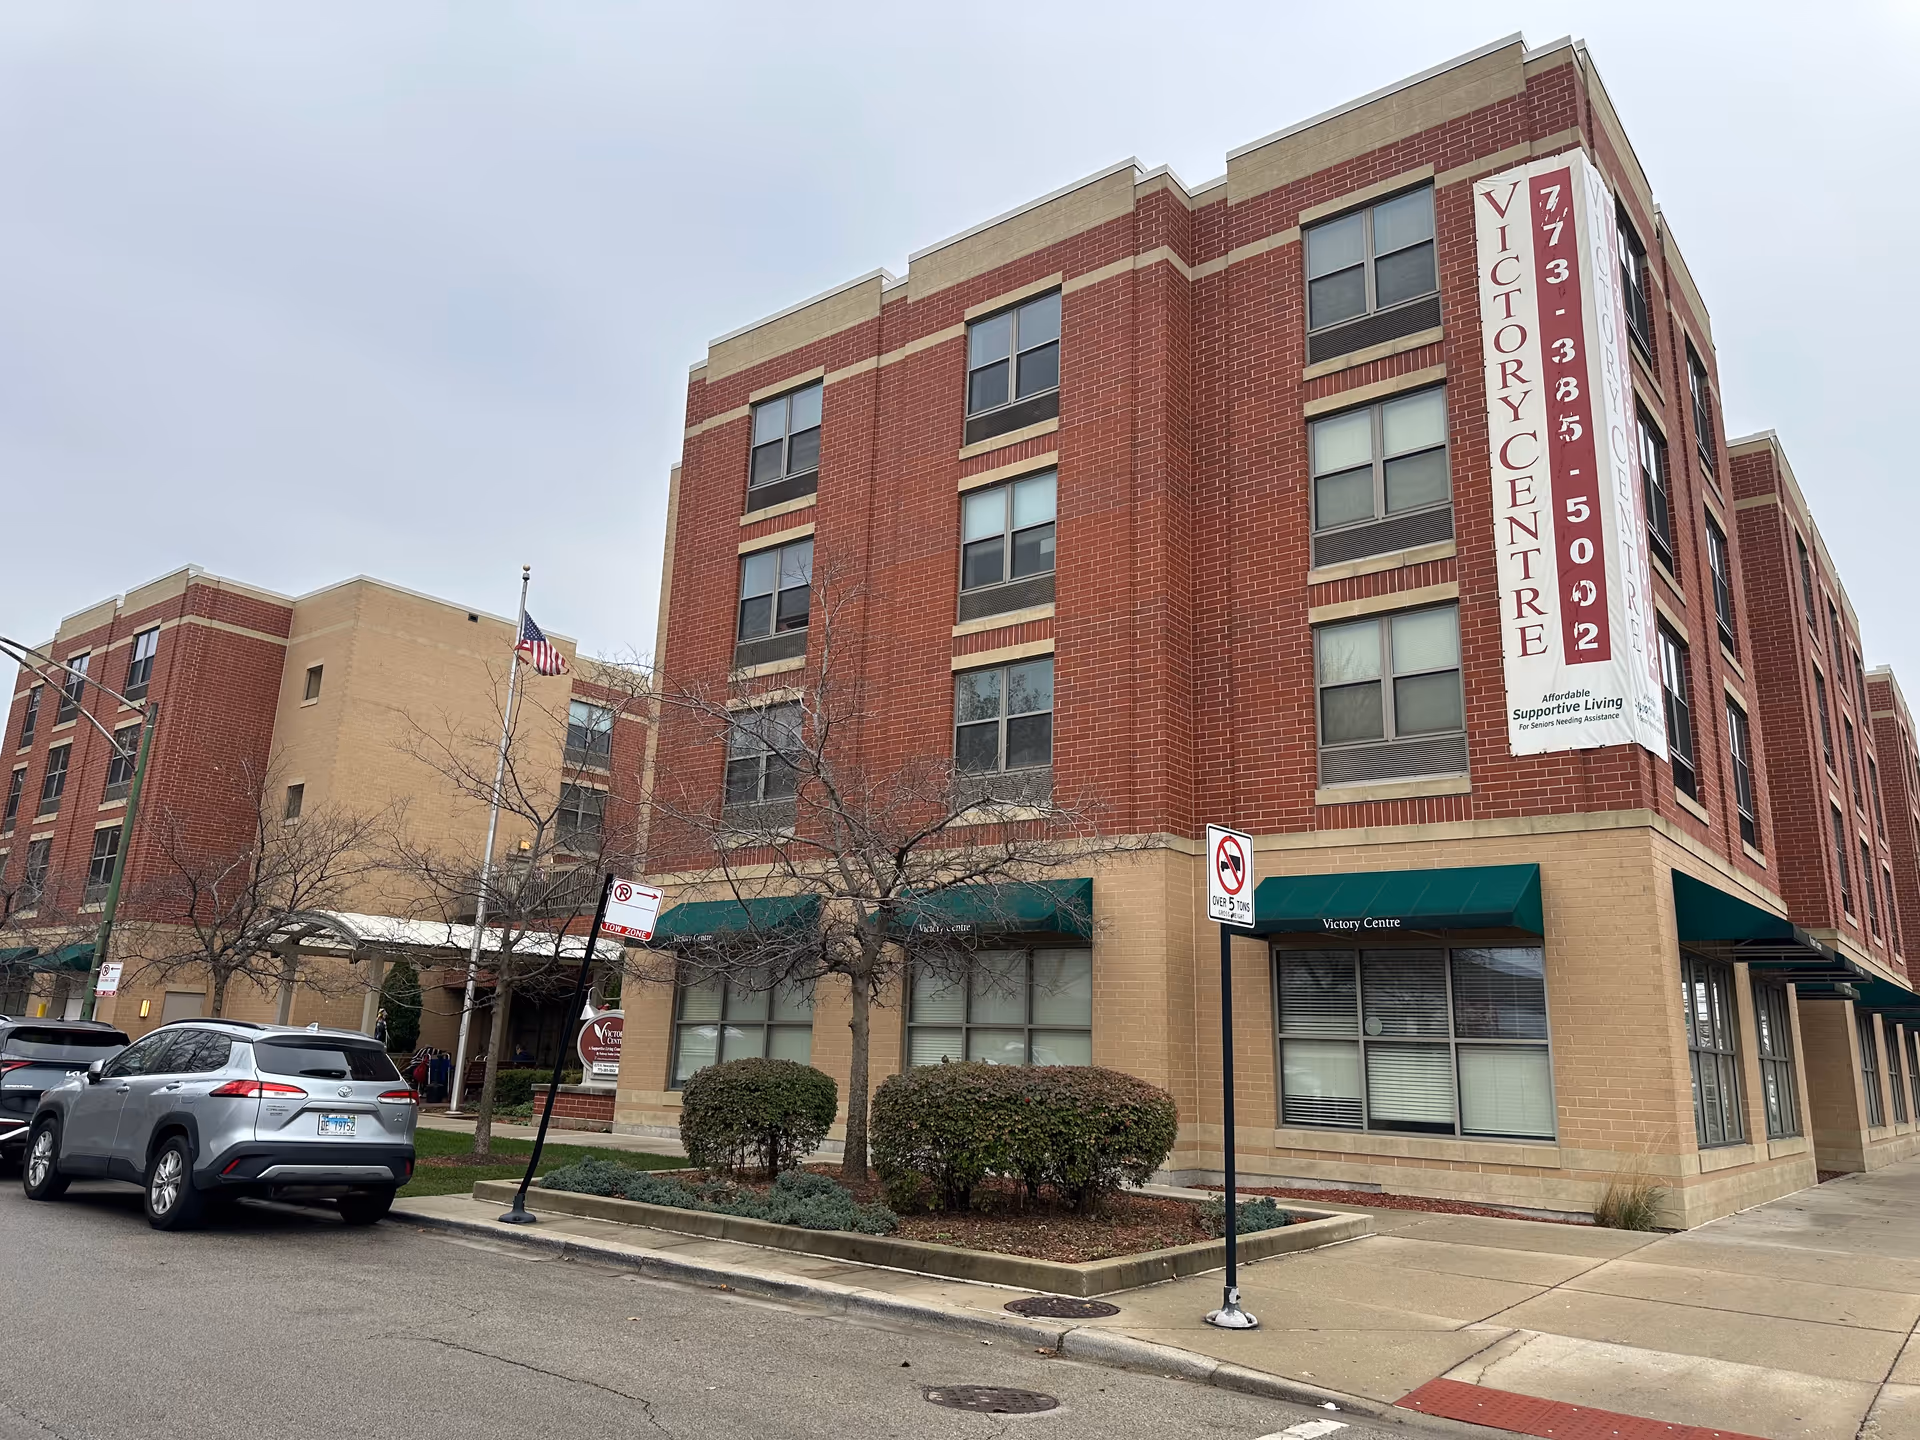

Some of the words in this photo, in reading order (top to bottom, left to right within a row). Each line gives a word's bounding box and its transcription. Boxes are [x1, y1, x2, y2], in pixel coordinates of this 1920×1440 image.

[1479, 180, 1533, 423] VICTORY
[1540, 185, 1599, 650] 773-385-5002
[1586, 166, 1619, 415] VICTORY
[1611, 424, 1641, 652] CENTRE
[1499, 430, 1549, 658] CENTRE
[1542, 688, 1590, 703] Affordable
[1512, 701, 1581, 721] Supportive
[1584, 696, 1623, 712] Living
[1518, 723, 1529, 731] For
[1530, 720, 1554, 730] Seniors
[1556, 716, 1582, 727] Needing
[1584, 712, 1620, 723] Assistance
[1212, 895, 1227, 907] OVER
[1228, 896, 1235, 911] 5
[1236, 900, 1251, 912] TONS
[605, 922, 622, 932] TOW
[625, 928, 647, 939] ZONE
[1322, 918, 1360, 931] Victory
[1363, 917, 1401, 928] Centre
